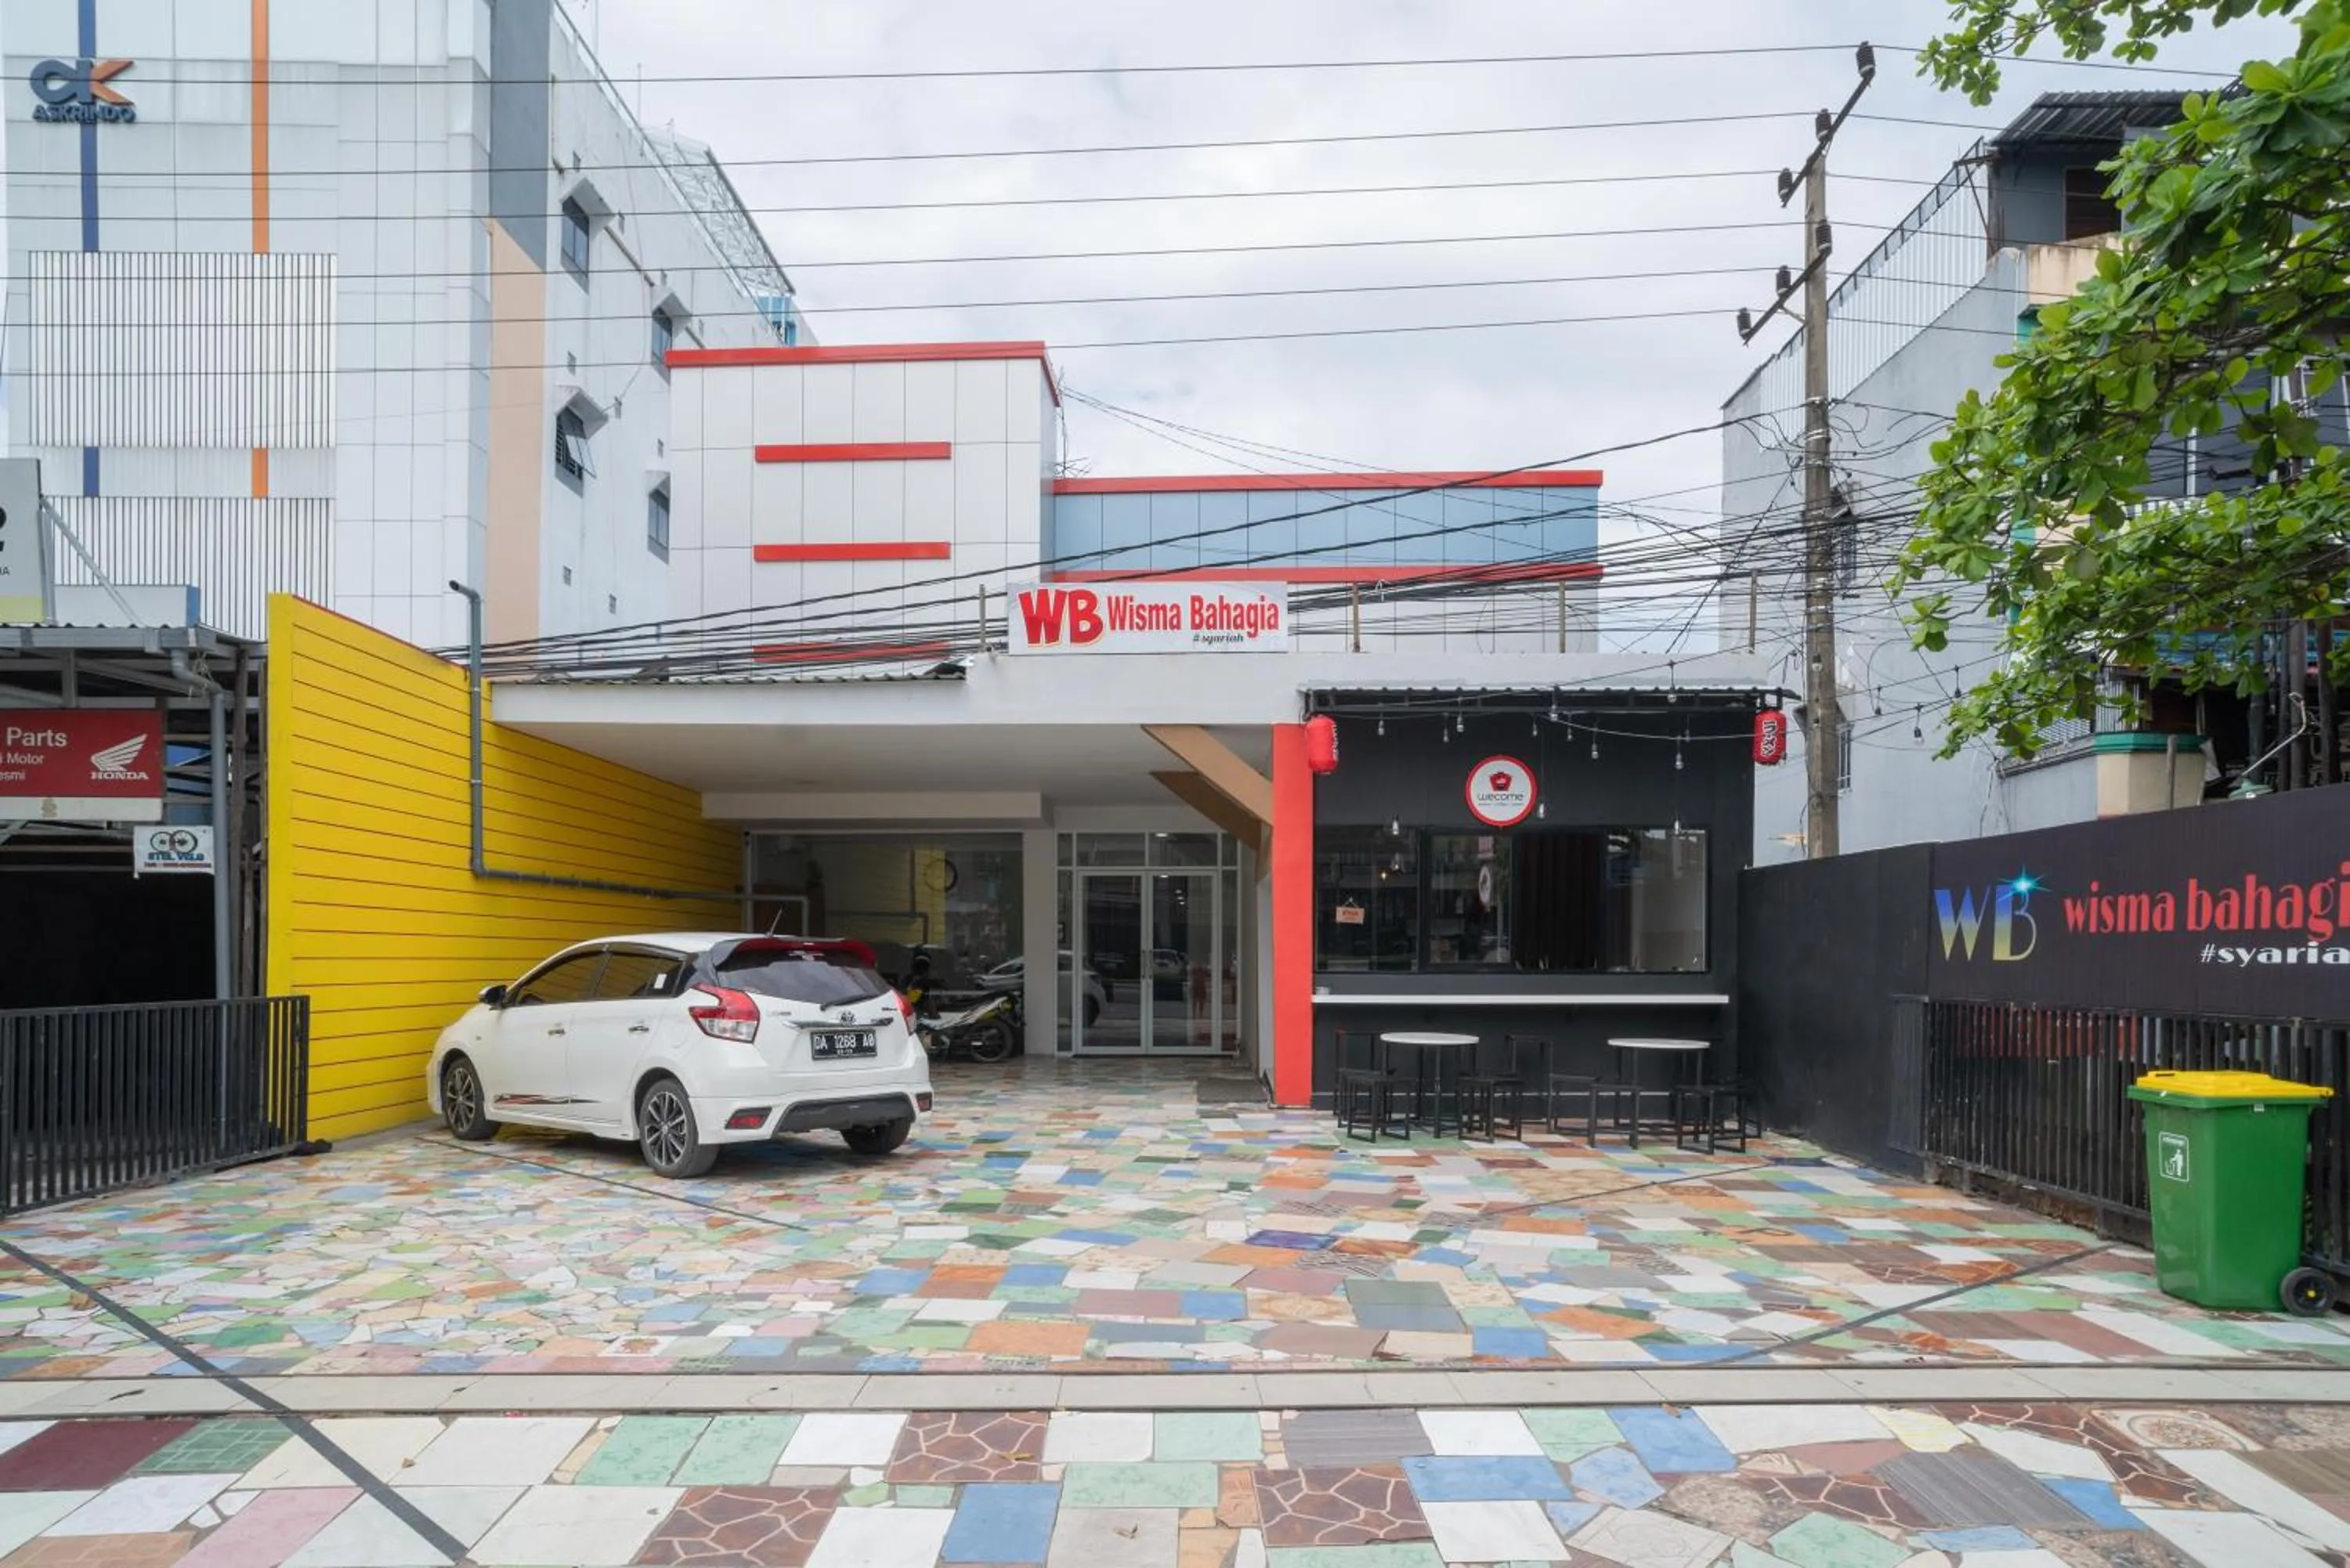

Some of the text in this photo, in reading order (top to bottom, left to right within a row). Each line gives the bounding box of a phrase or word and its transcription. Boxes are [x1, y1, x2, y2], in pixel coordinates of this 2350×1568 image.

[32, 104, 136, 123] ASKRINDO
[1018, 588, 1279, 646] WB Wisma Bahagia
[6, 727, 67, 748] Parts
[6, 752, 45, 765] Motor
[91, 771, 150, 780] HONDA
[1934, 884, 2037, 962] WB
[2063, 881, 2175, 934] wisma
[833, 1034, 856, 1049] 1268
